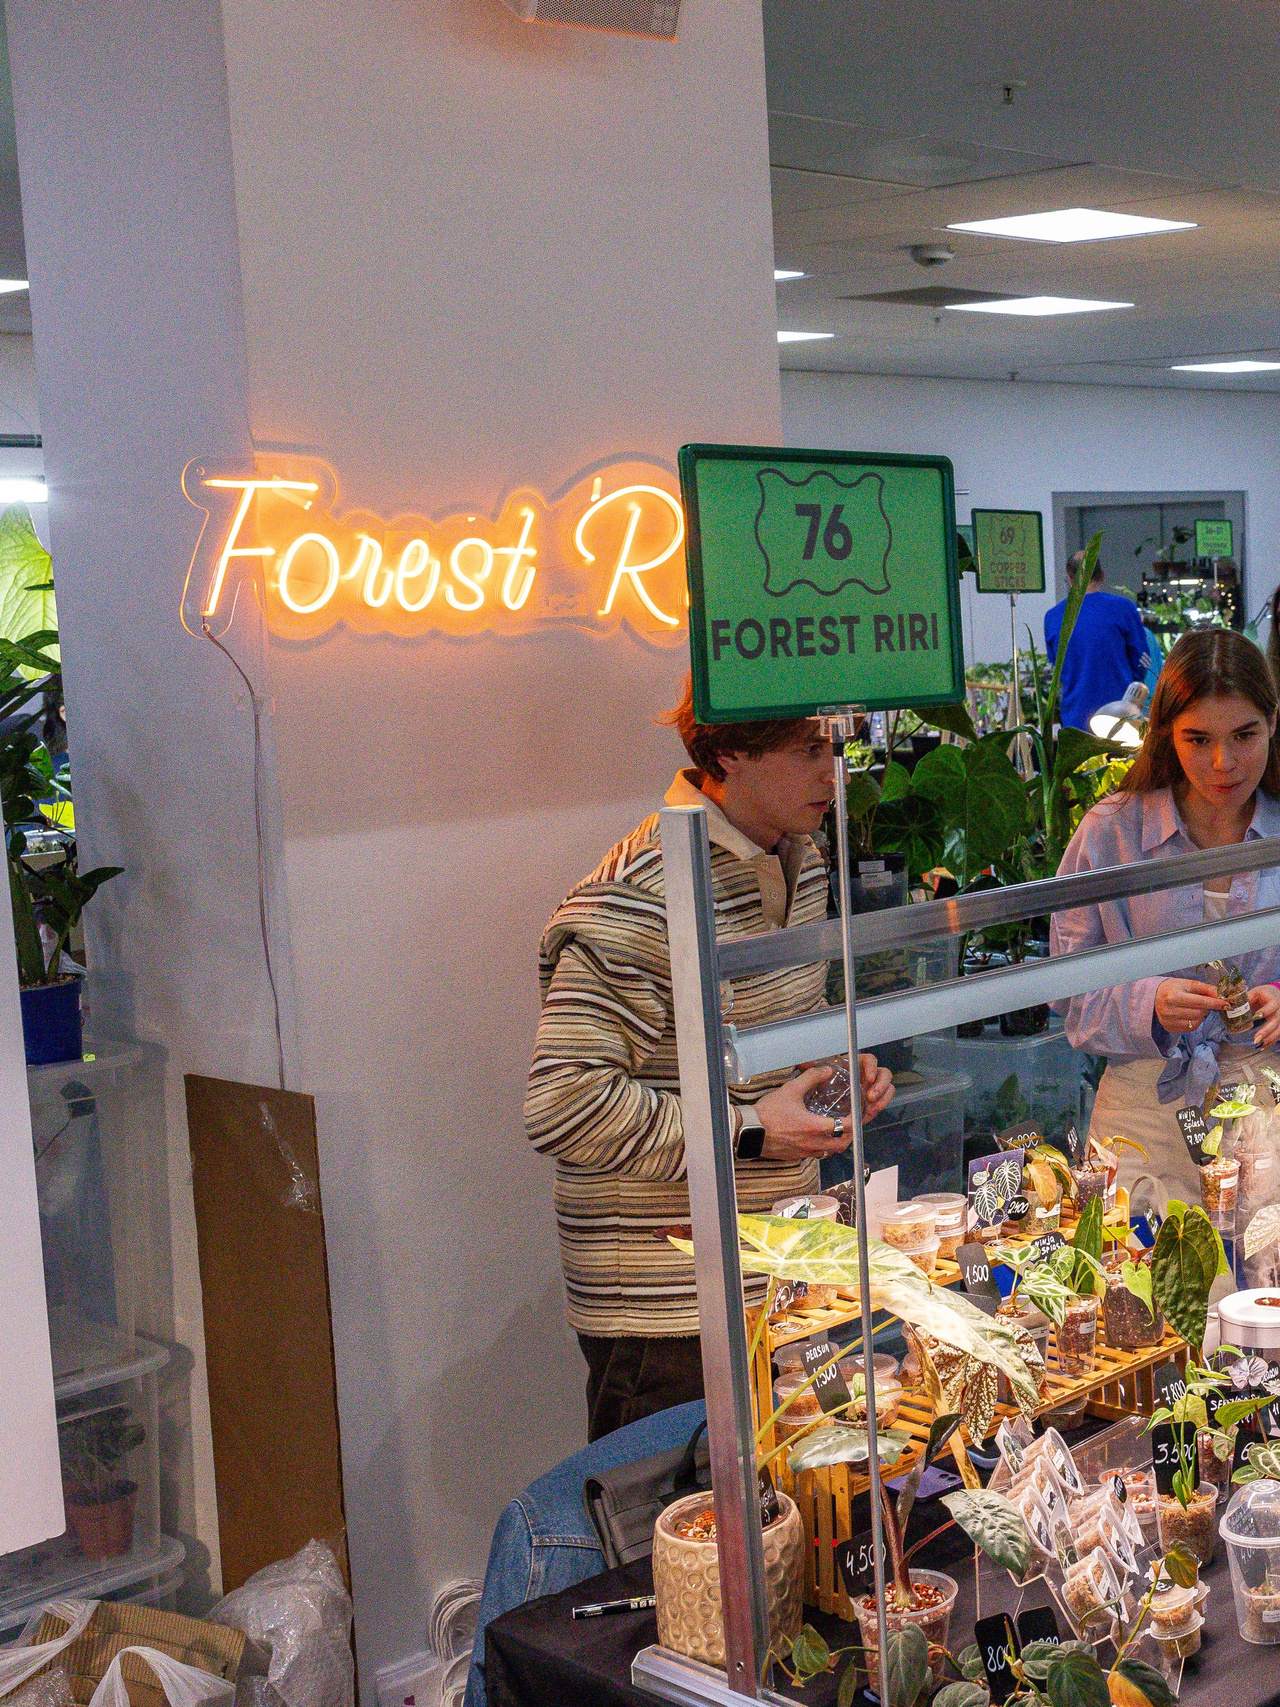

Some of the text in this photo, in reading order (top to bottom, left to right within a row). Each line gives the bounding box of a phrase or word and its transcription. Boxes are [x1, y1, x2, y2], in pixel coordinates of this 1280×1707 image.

[201, 478, 536, 614] Forest
[794, 504, 853, 561] 76
[1000, 526, 1015, 545] 69
[711, 612, 939, 661] FOREST RIRI
[965, 1264, 989, 1286] 1.500
[1161, 1380, 1187, 1406] 7.800
